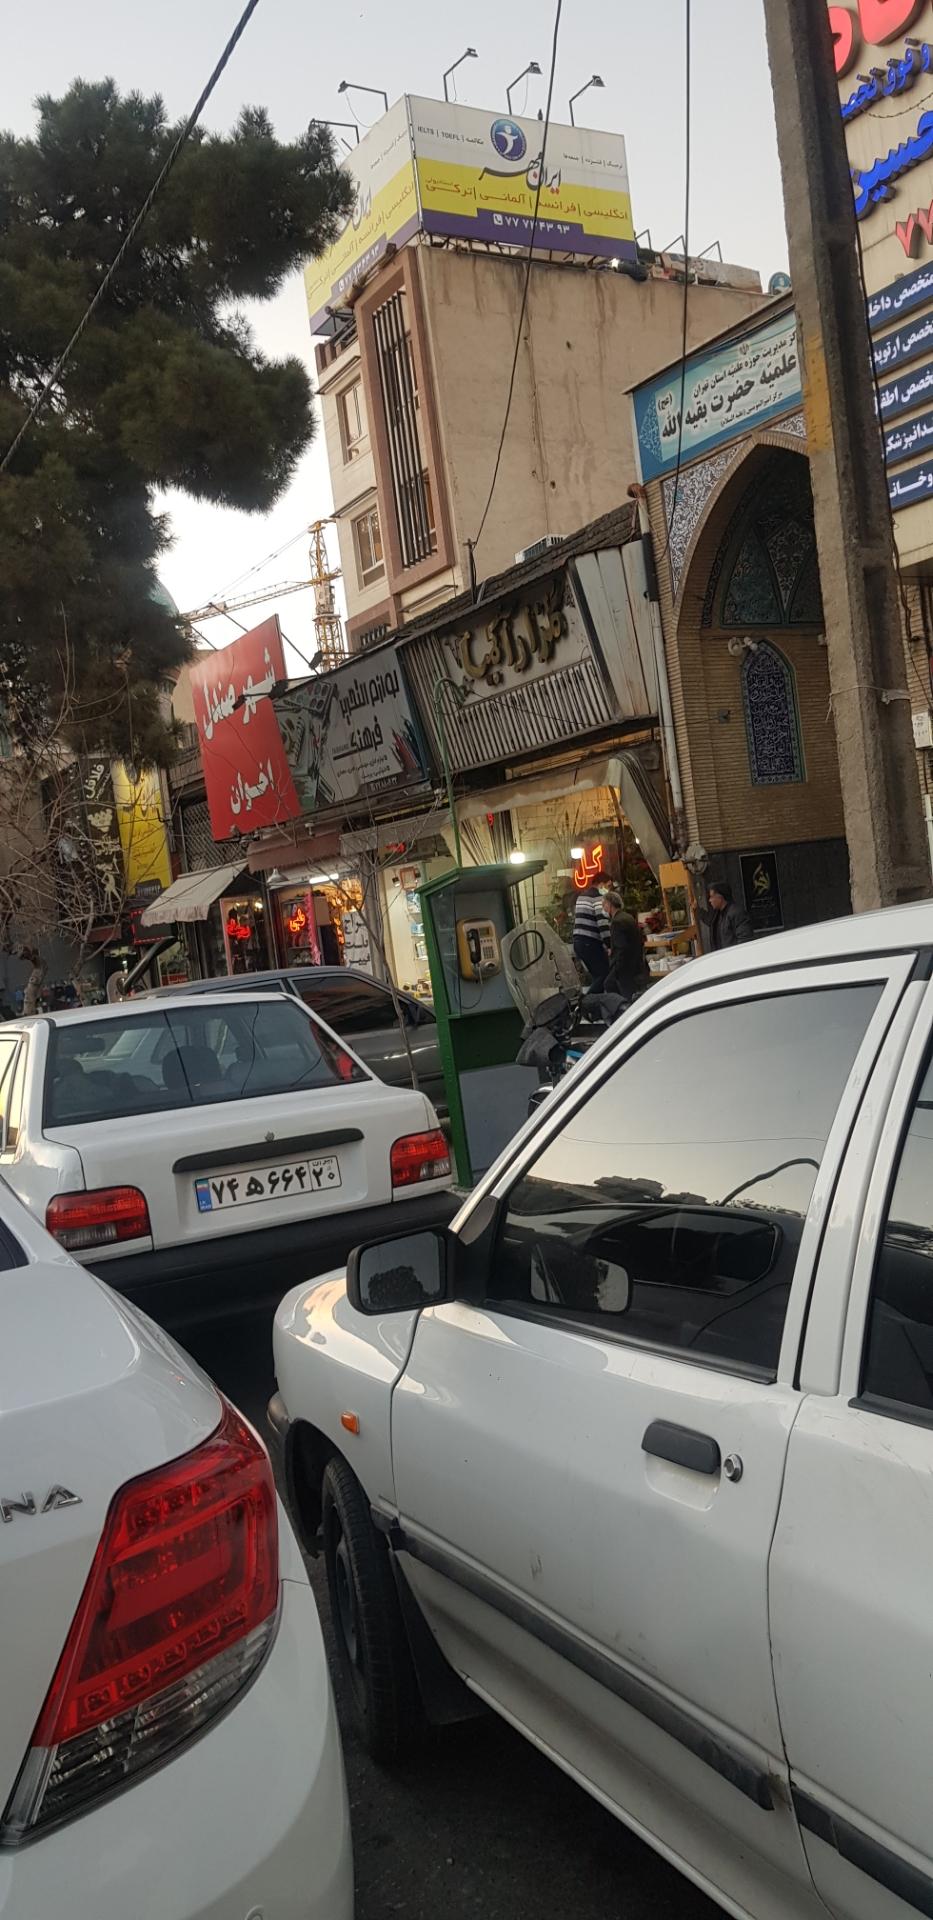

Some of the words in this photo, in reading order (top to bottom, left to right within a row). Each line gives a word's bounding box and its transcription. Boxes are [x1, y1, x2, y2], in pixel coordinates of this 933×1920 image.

[425, 183, 473, 197] ترکی
[480, 192, 526, 205] آلمانی
[583, 208, 628, 220] انگلیسی
[868, 295, 892, 318] داخل
[711, 379, 755, 413] حضرت
[685, 400, 707, 429] بقیه
[242, 647, 277, 725] شهر
[339, 678, 370, 726] التحریر
[369, 669, 400, 707] لوازم
[202, 678, 236, 740] صندل
[85, 762, 105, 799] فلافل
[574, 843, 603, 889] گل
